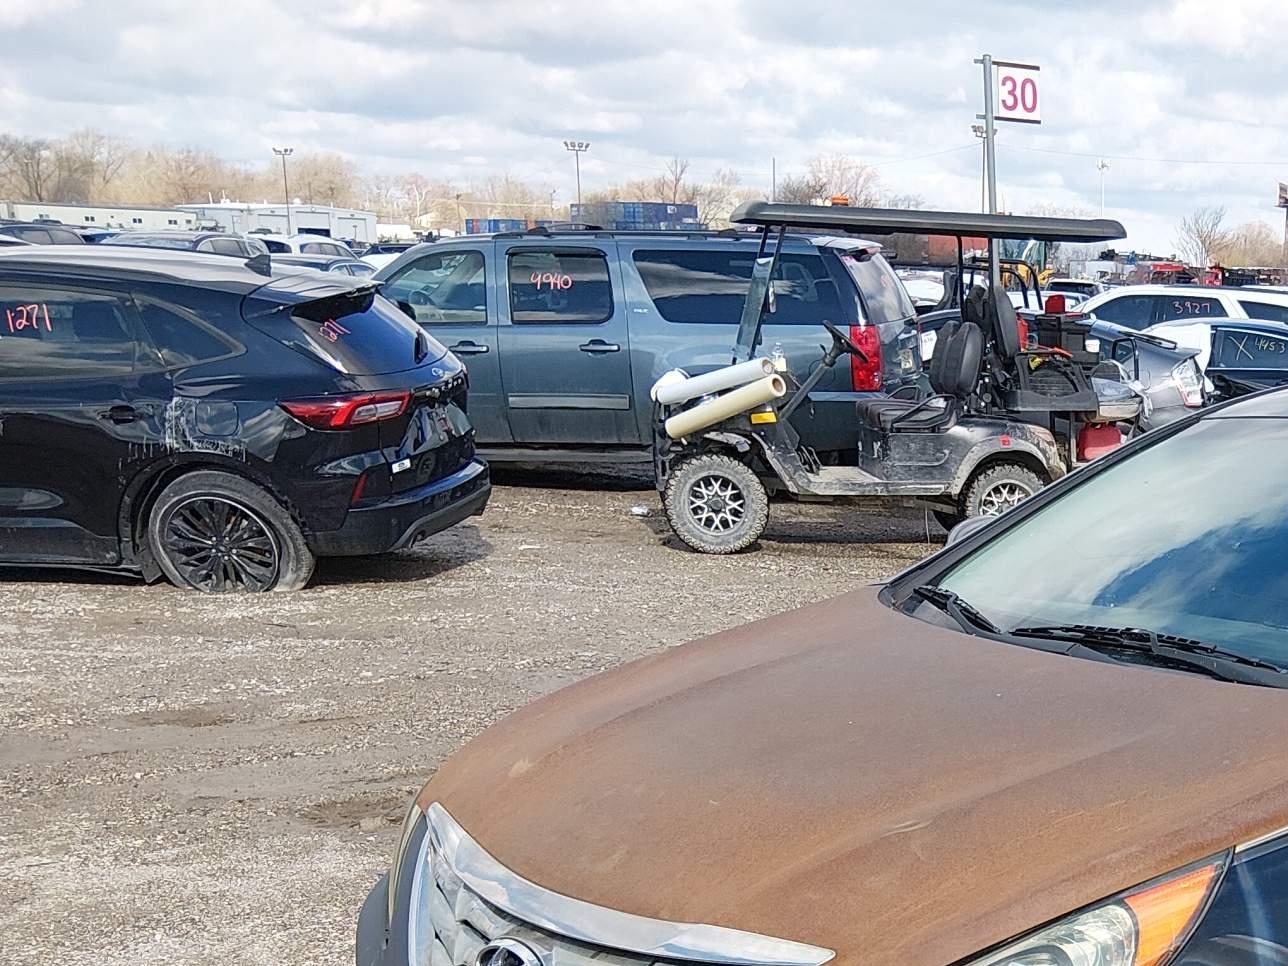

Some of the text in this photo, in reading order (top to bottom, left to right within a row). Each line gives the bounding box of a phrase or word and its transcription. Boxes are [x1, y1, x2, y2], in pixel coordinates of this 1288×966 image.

[1001, 75, 1038, 113] 30
[530, 271, 572, 290] 4940
[6, 303, 52, 333] 1271
[1172, 301, 1210, 314] 3927
